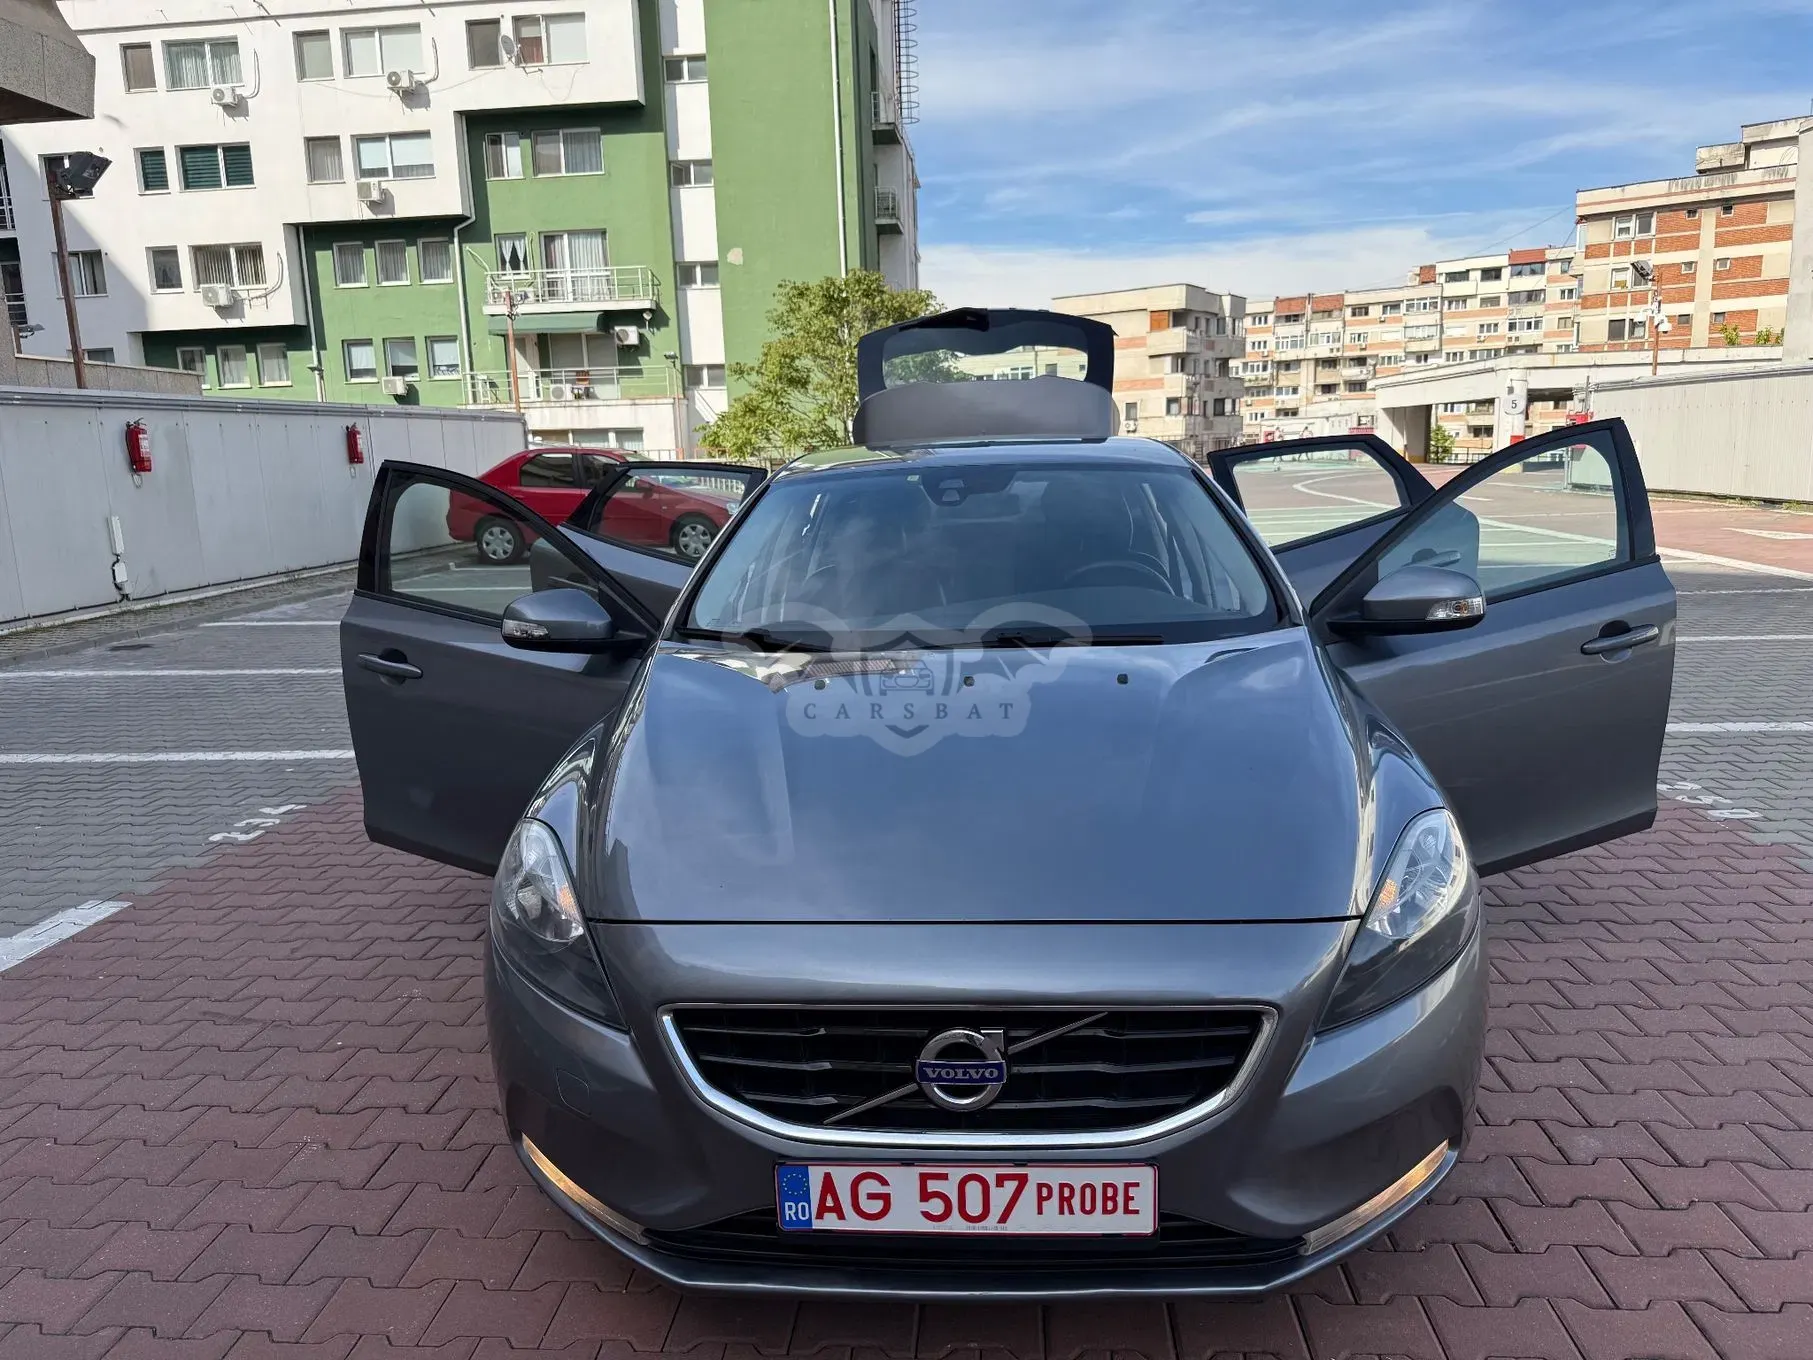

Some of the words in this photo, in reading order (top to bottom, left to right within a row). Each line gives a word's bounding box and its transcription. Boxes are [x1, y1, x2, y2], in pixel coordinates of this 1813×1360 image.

[1511, 400, 1518, 409] 5
[923, 1067, 999, 1079] VOLVO
[815, 1171, 892, 1221] AG
[919, 1172, 1029, 1224] 507
[1036, 1181, 1140, 1215] PROBE
[785, 1202, 810, 1221] RO
